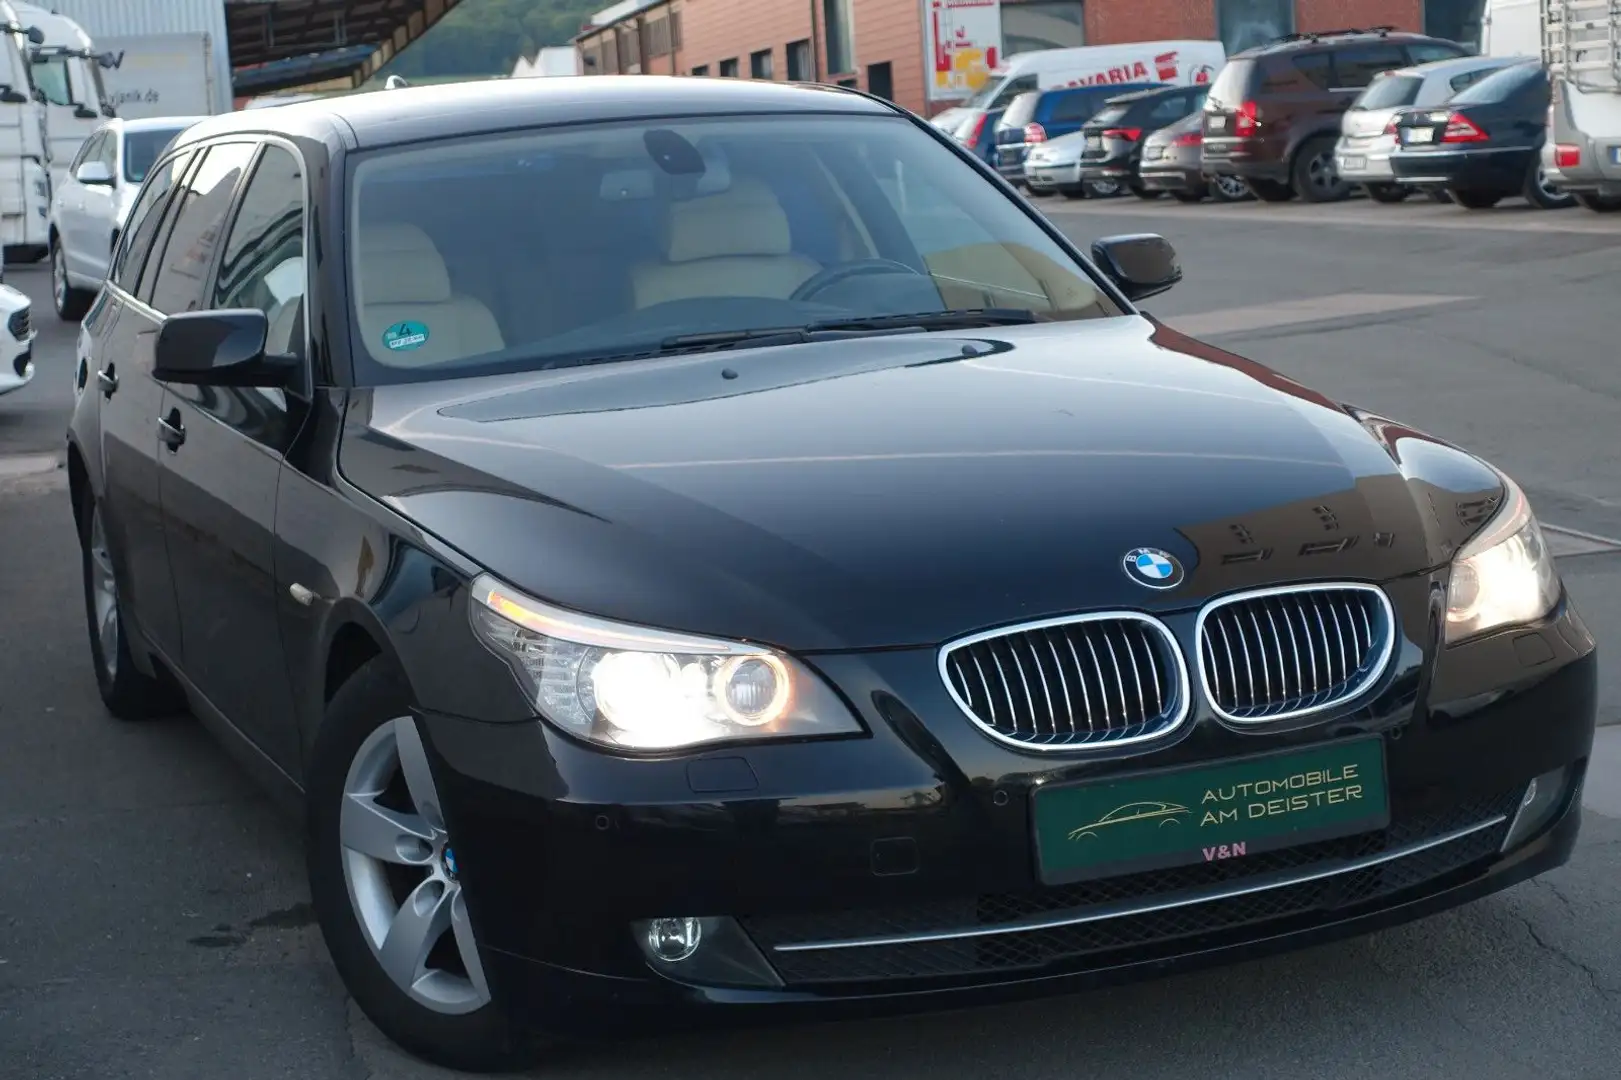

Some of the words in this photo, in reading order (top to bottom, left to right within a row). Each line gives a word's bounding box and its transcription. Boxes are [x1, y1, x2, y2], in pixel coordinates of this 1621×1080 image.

[399, 323, 412, 336] 4
[1201, 763, 1359, 805] AUTOMOBILE
[1200, 808, 1238, 827] AM
[1248, 784, 1363, 819] DEISTER
[1202, 841, 1246, 862] V&N
